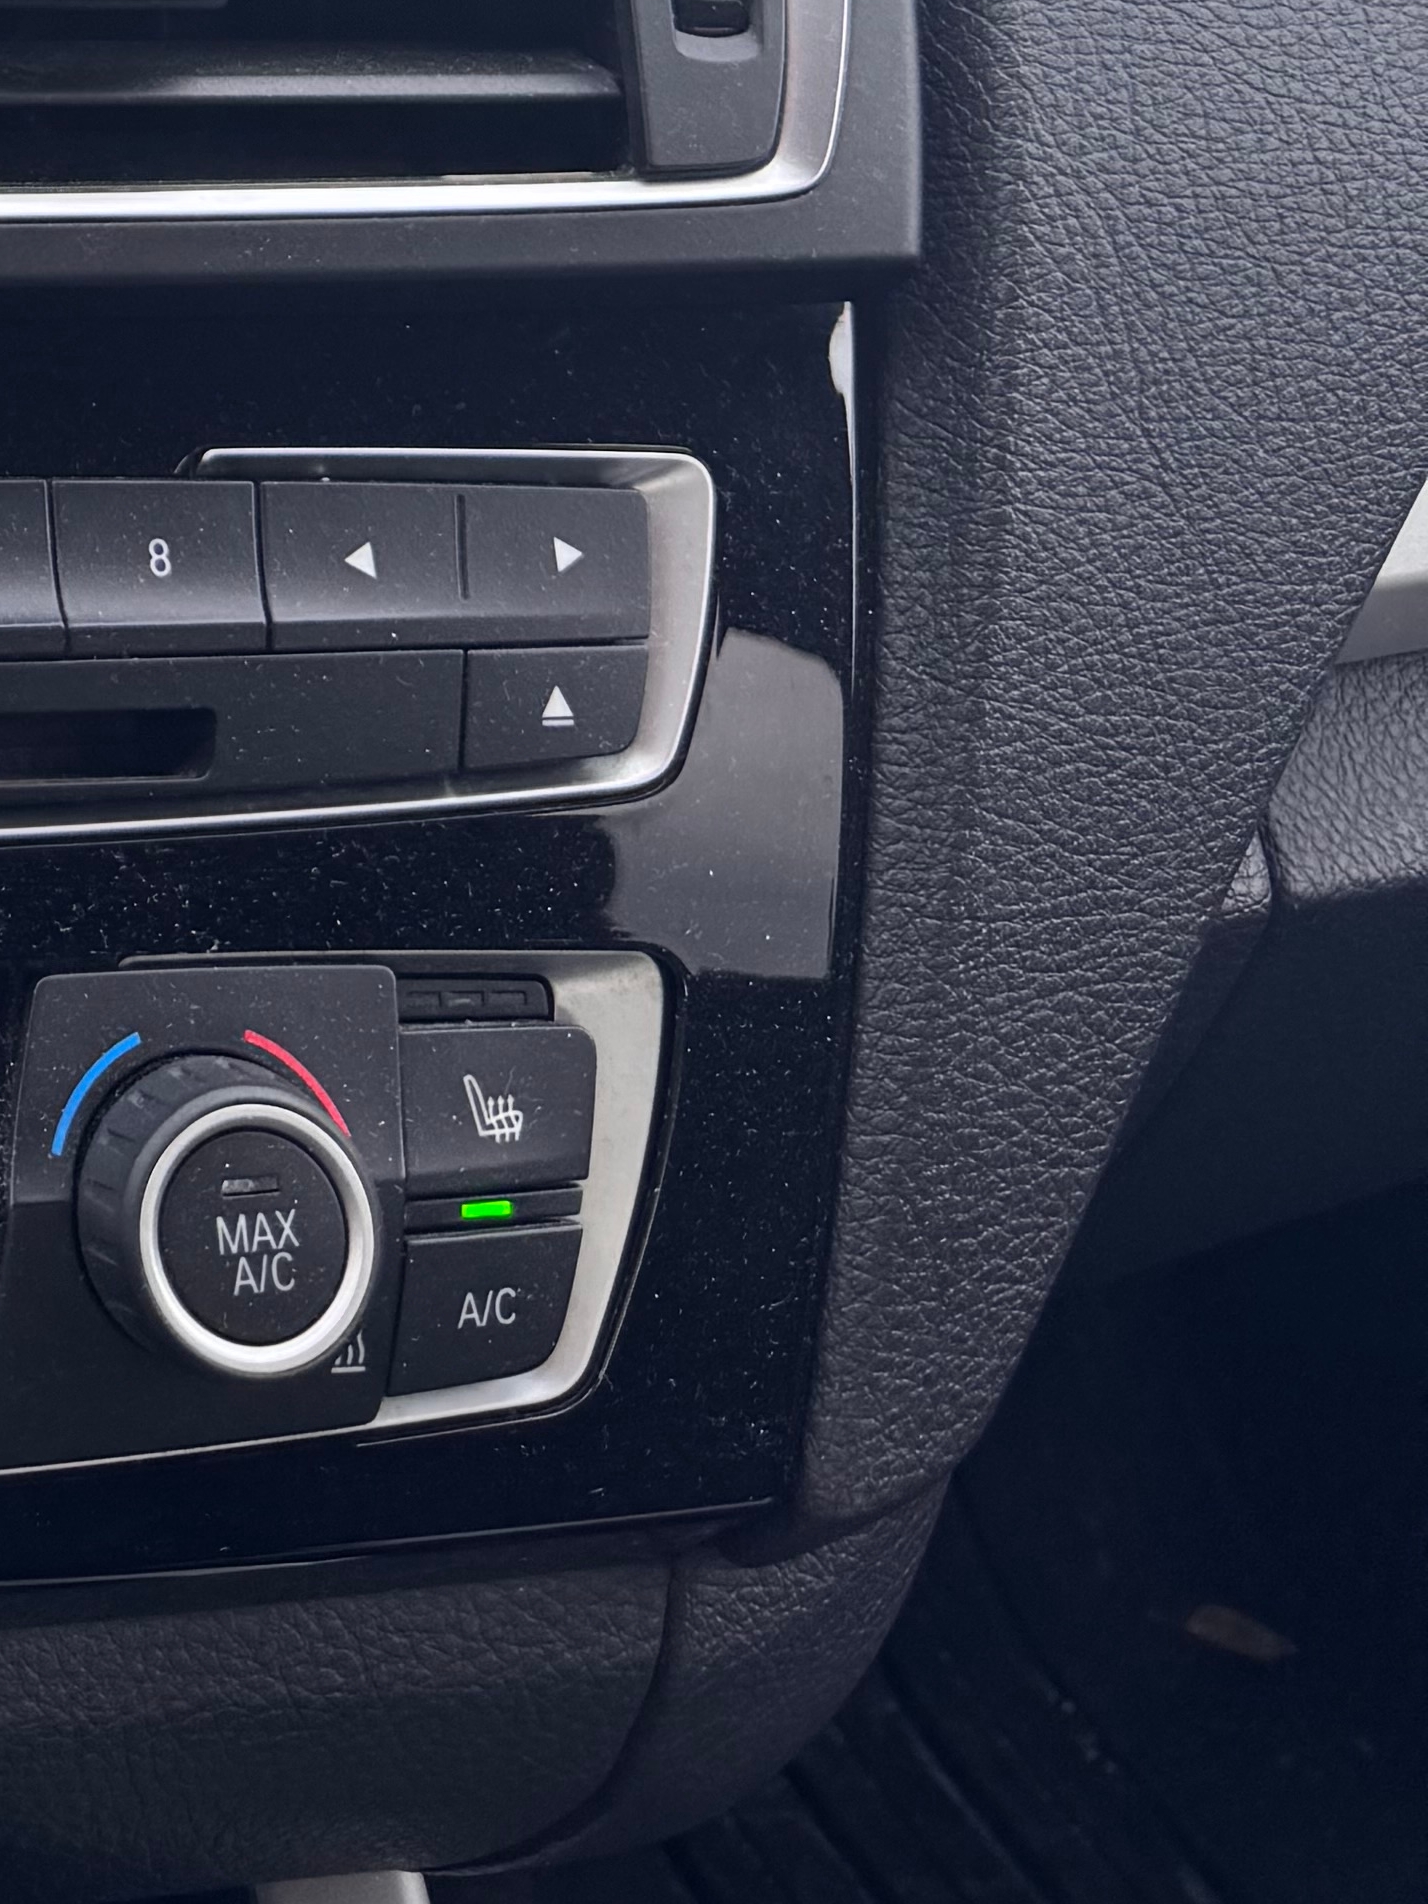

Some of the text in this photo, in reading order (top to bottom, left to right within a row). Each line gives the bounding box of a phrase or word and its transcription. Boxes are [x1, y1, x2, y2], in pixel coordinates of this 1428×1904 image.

[149, 539, 171, 577] 8
[216, 1213, 301, 1252] MAX
[231, 1251, 295, 1296] A/C
[458, 1288, 516, 1328] A/C
